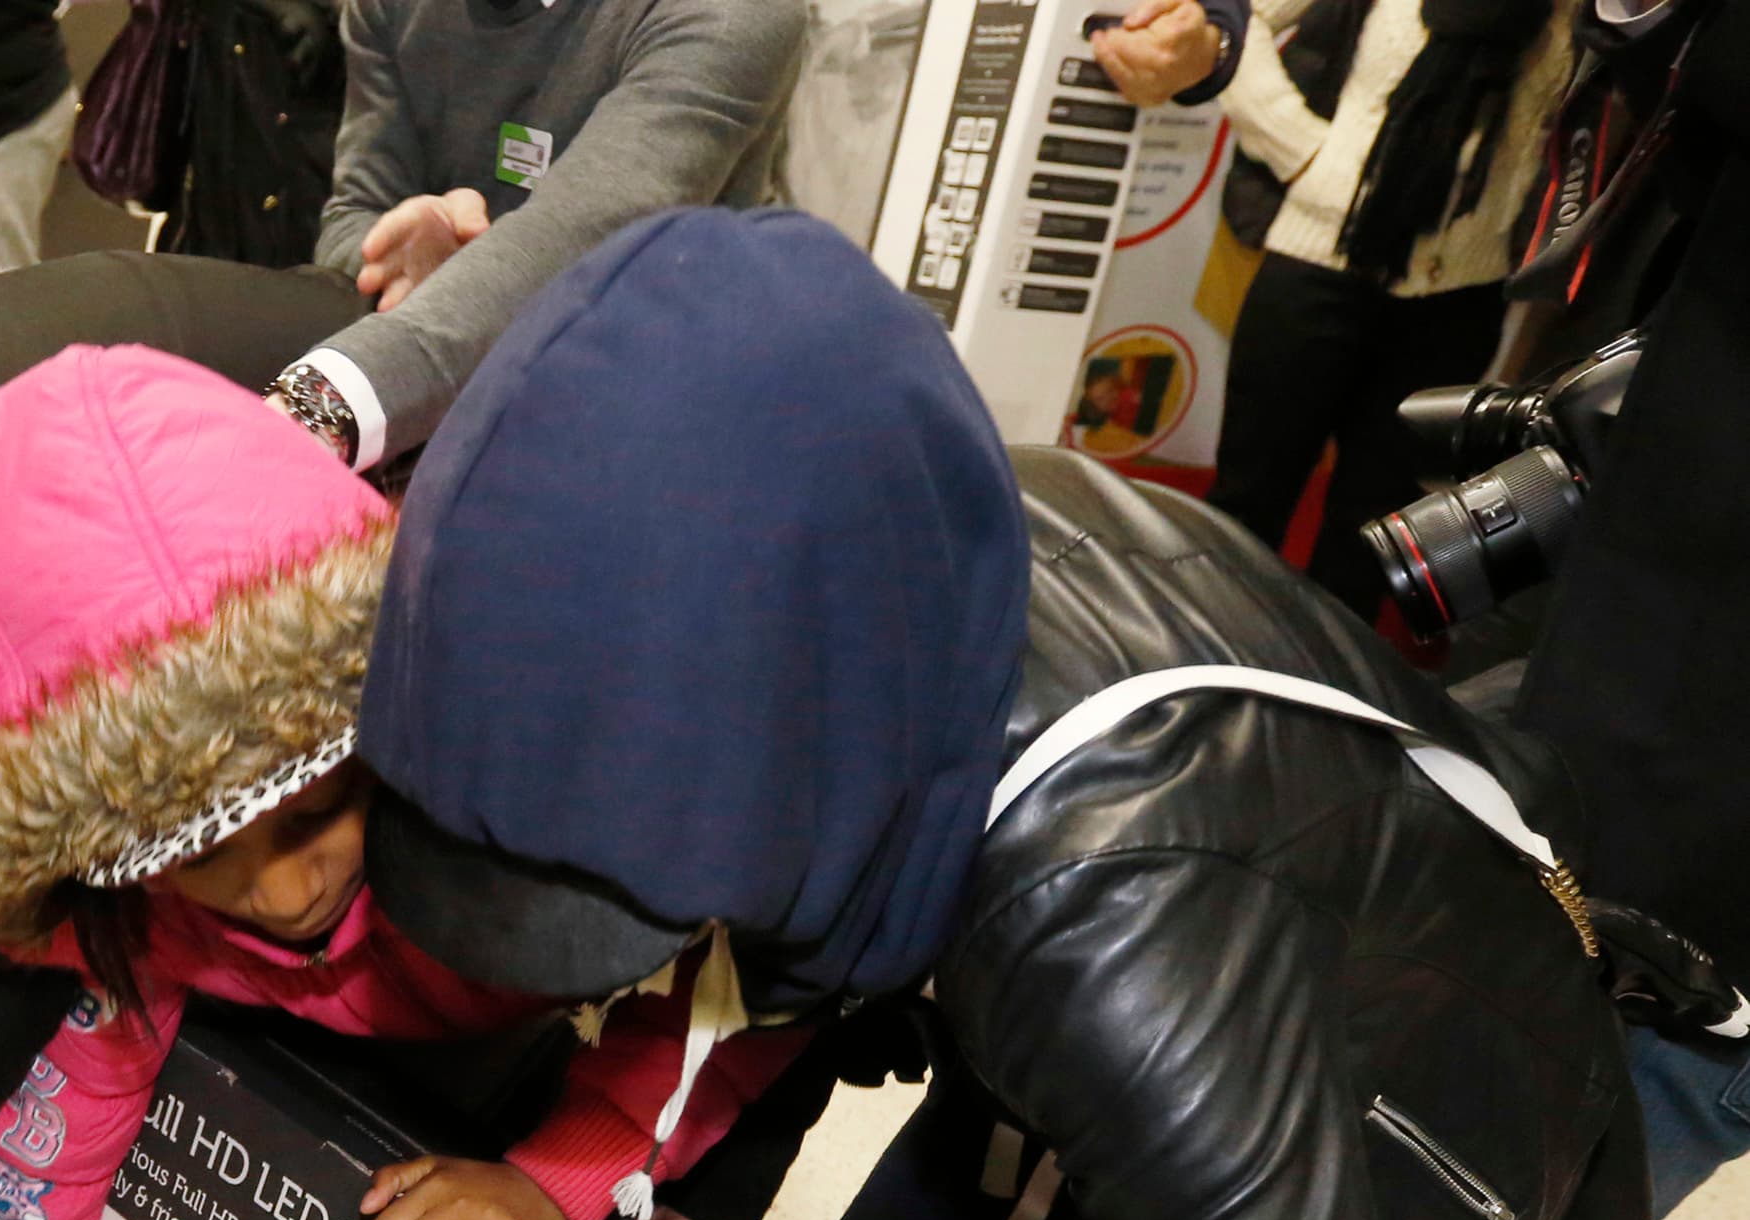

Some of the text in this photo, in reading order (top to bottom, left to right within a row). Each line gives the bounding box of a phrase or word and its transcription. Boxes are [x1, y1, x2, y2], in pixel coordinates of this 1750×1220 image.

[144, 1093, 185, 1143] ull
[189, 1115, 250, 1186] HD
[134, 1185, 148, 1208] &
[172, 1173, 208, 1215] Full
